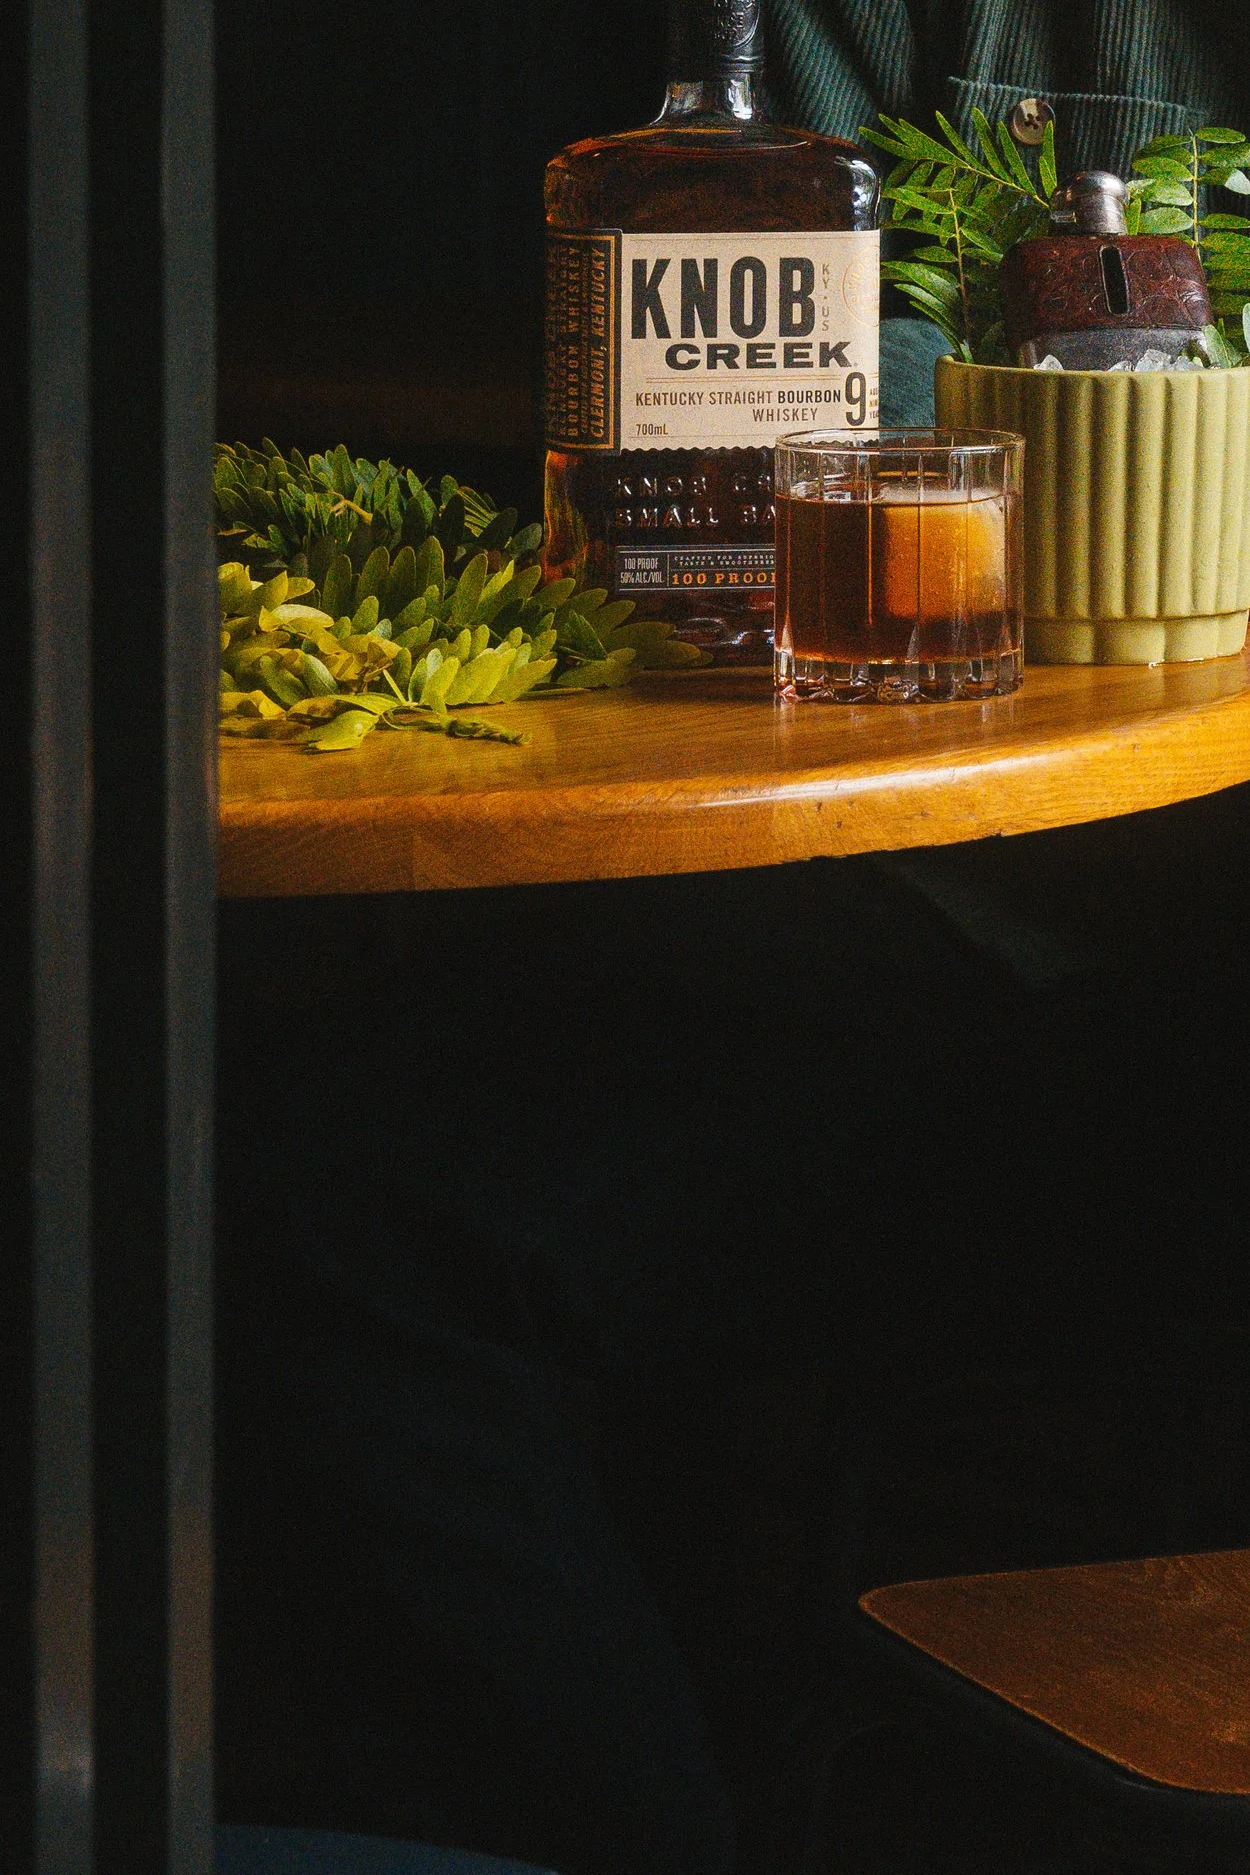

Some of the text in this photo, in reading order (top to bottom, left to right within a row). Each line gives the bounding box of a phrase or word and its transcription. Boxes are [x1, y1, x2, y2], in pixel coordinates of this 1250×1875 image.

[631, 256, 816, 339] KNOB
[567, 246, 580, 437] BOURBON WHISKEY
[590, 247, 607, 437] CLERMONT, KENTUCKY
[664, 341, 852, 370] CREEK
[635, 389, 842, 407] KENTUCKY STRAIGHT BOURBON
[845, 371, 867, 426] 9
[752, 408, 818, 423] WHISKEY
[635, 423, 669, 436] 700mL
[615, 504, 720, 527] SMALL
[624, 557, 659, 570] 100 PROOF
[672, 572, 708, 585] 100
